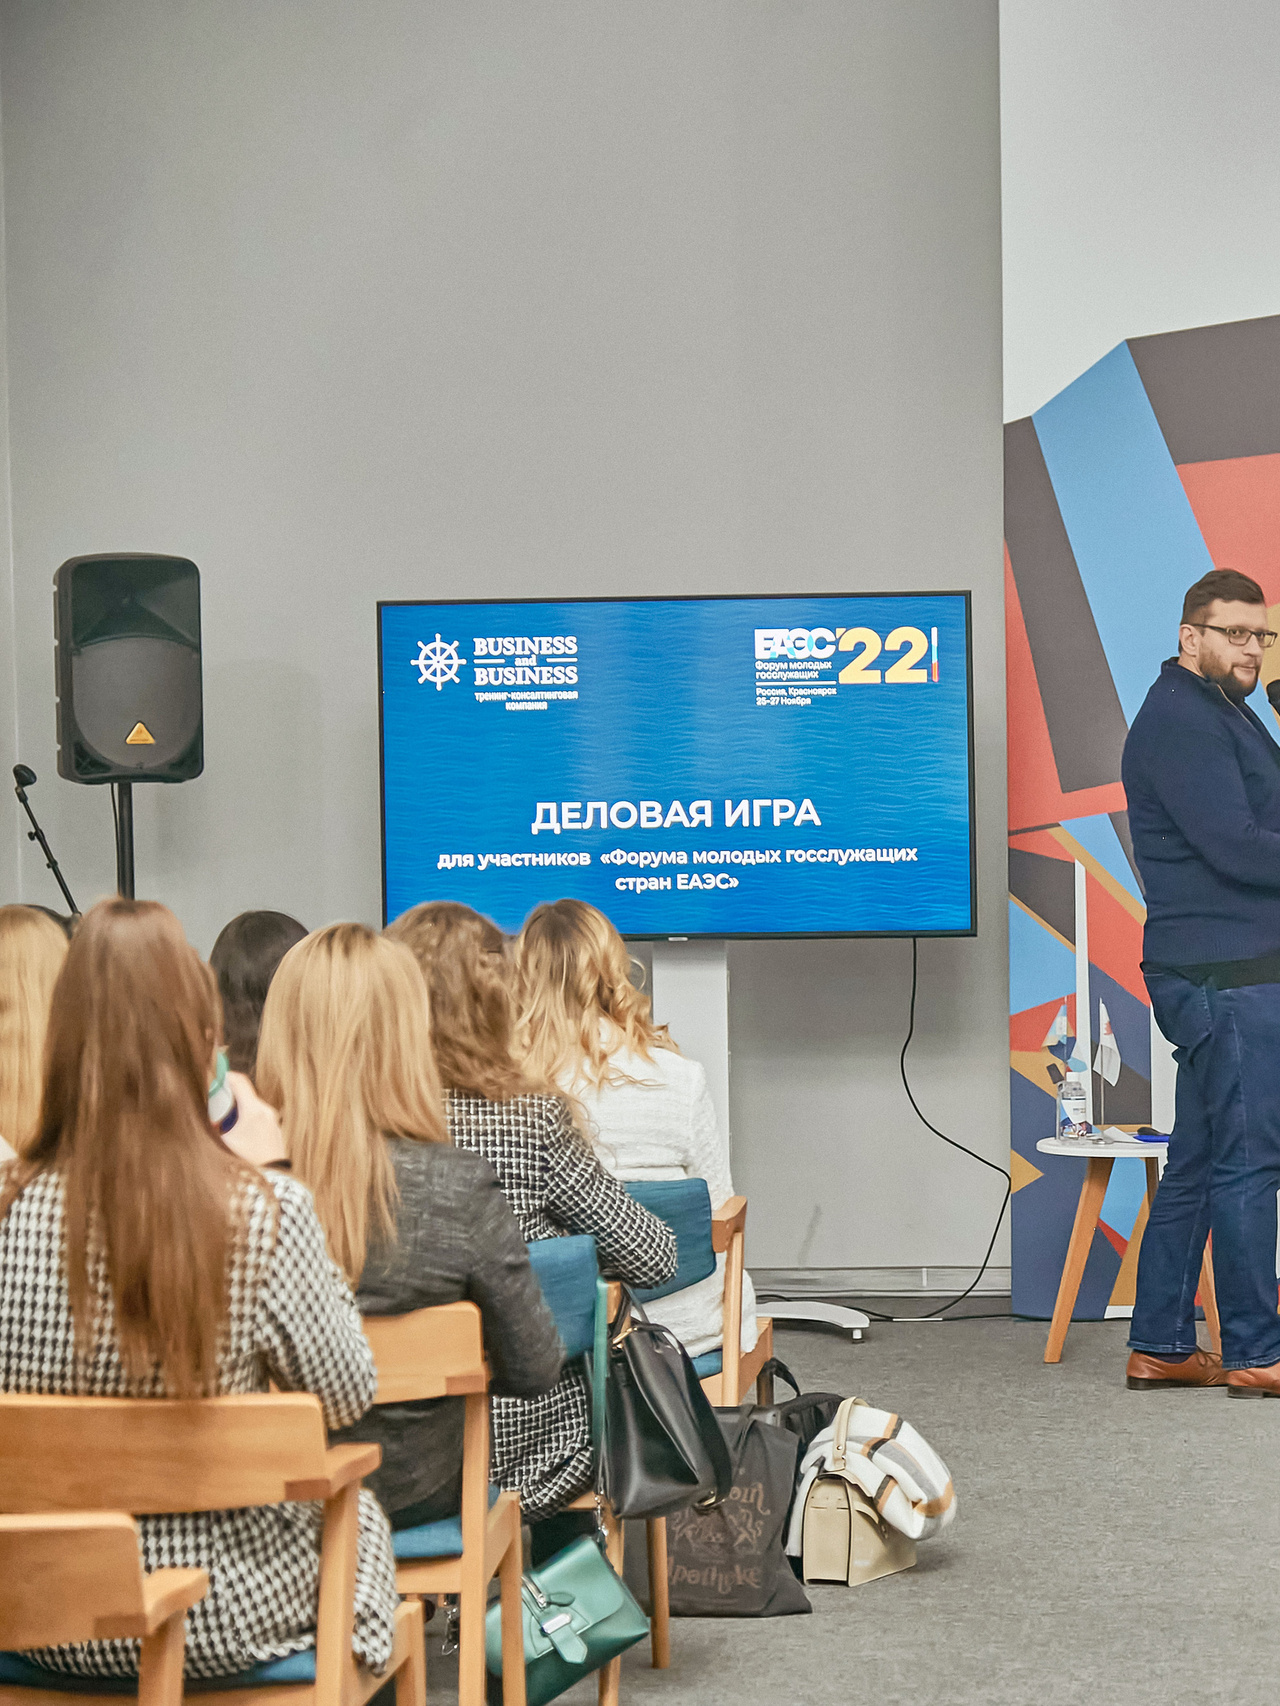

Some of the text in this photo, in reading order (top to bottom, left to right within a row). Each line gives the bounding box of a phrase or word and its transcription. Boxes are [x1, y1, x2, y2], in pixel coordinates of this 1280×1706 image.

[473, 636, 578, 656] BUSINESS
[514, 654, 537, 666] and
[755, 660, 832, 671] Форум молодых
[473, 666, 578, 686] BUSINESS
[756, 671, 819, 681] госслужащих
[474, 691, 579, 703] тренинг-консалтинговая
[756, 687, 837, 697] Россия, Красноярск
[505, 701, 548, 711] компания
[780, 697, 811, 706] Ноября
[531, 798, 822, 835] ДЕЛОВАЯ ИГРА
[437, 847, 918, 871] для участников «Форума молодых госслужащих
[615, 873, 739, 894] стран ЕАЭС»
